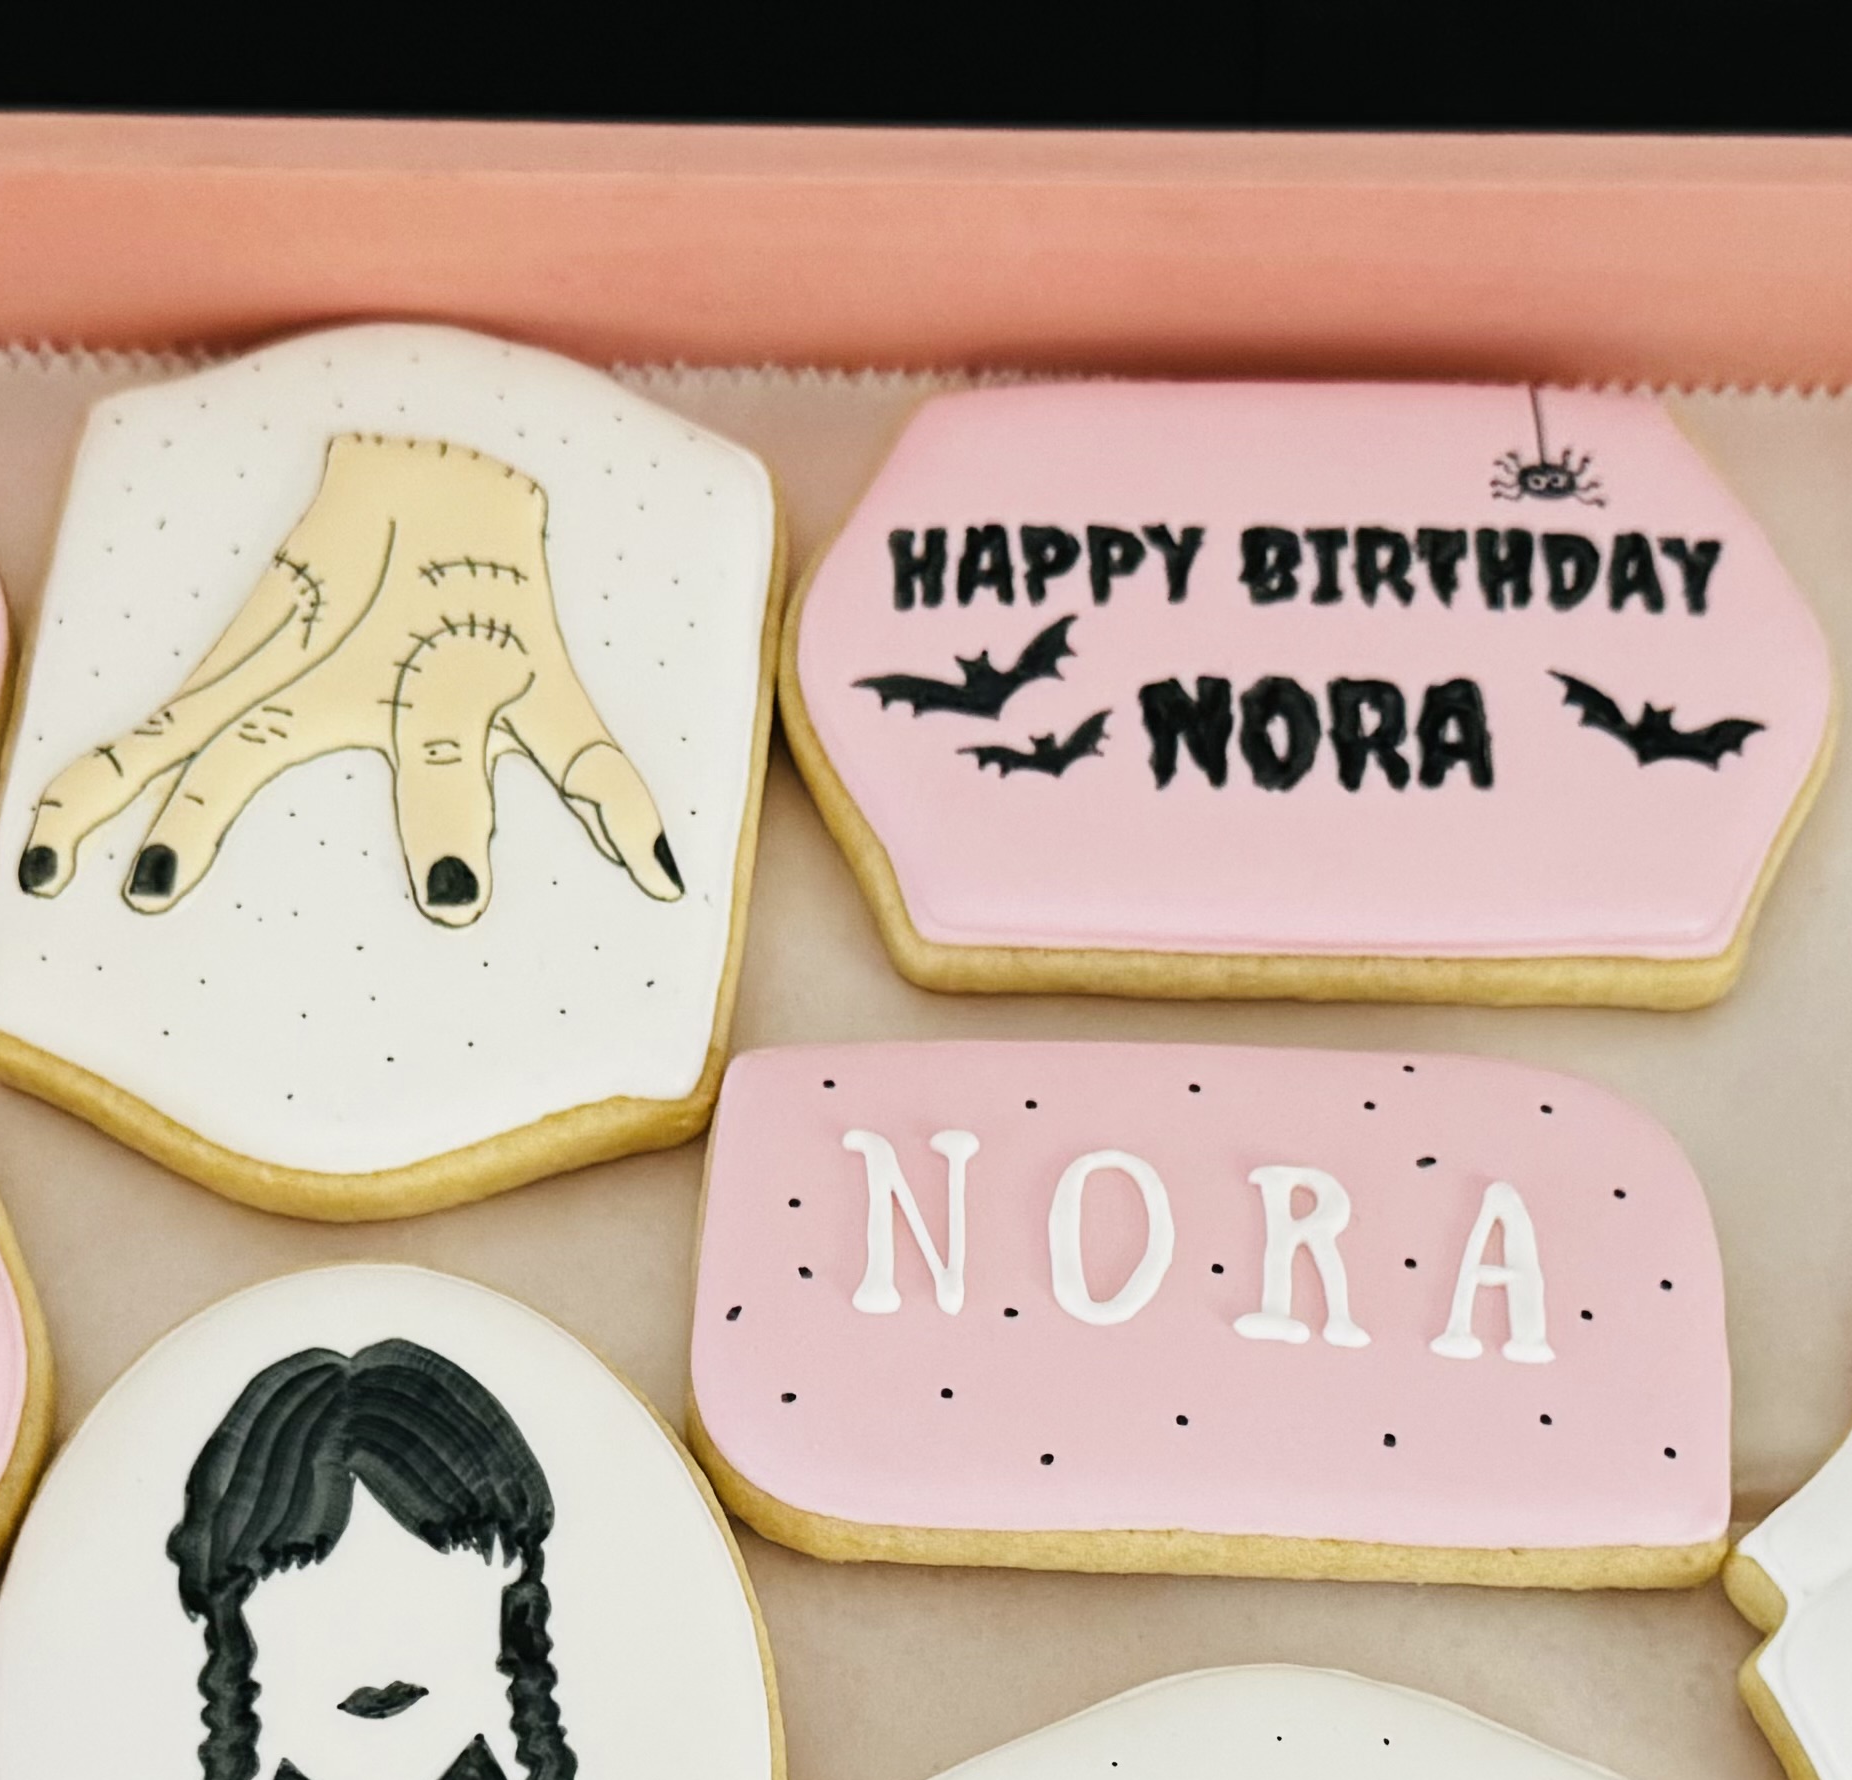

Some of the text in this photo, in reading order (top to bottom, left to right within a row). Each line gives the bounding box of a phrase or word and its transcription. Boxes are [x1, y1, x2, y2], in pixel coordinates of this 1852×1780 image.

[887, 522, 1723, 616] HAPPY BIRTHDAY
[1137, 673, 1495, 793] NORA
[840, 1128, 1558, 1365] NORA
